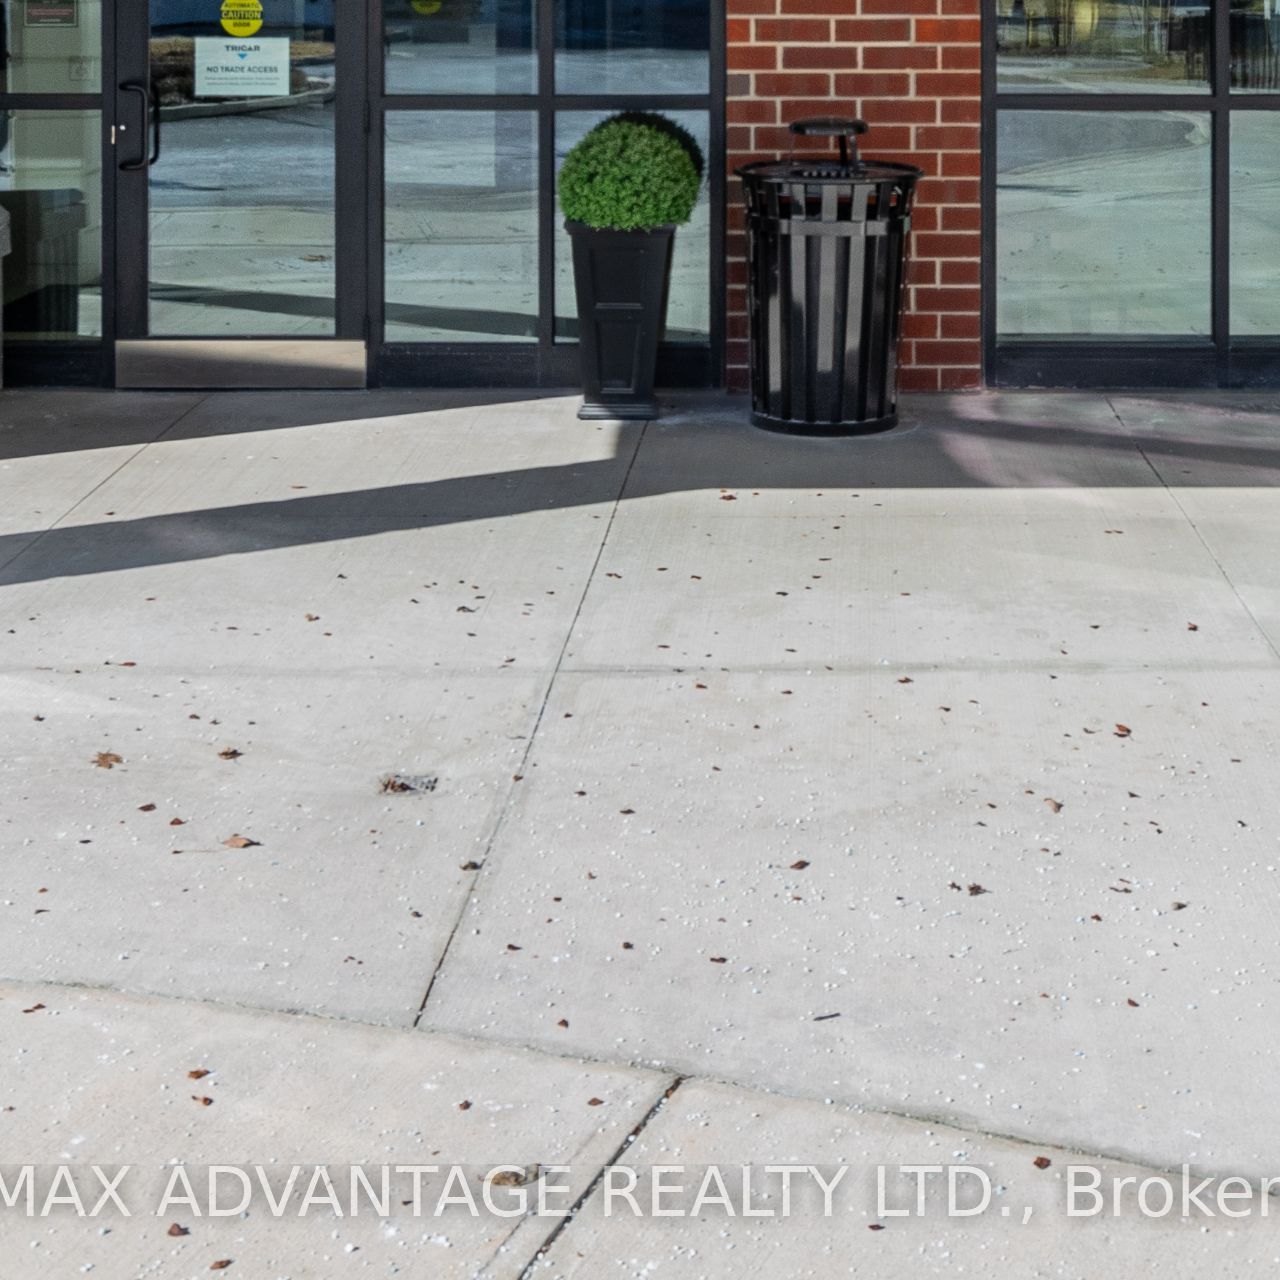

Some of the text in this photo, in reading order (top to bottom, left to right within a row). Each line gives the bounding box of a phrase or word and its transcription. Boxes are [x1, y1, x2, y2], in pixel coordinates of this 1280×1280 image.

[221, 10, 261, 20] CAUTION
[224, 44, 260, 52] TRICAR
[206, 65, 279, 73] NO TRADE ACCESS
